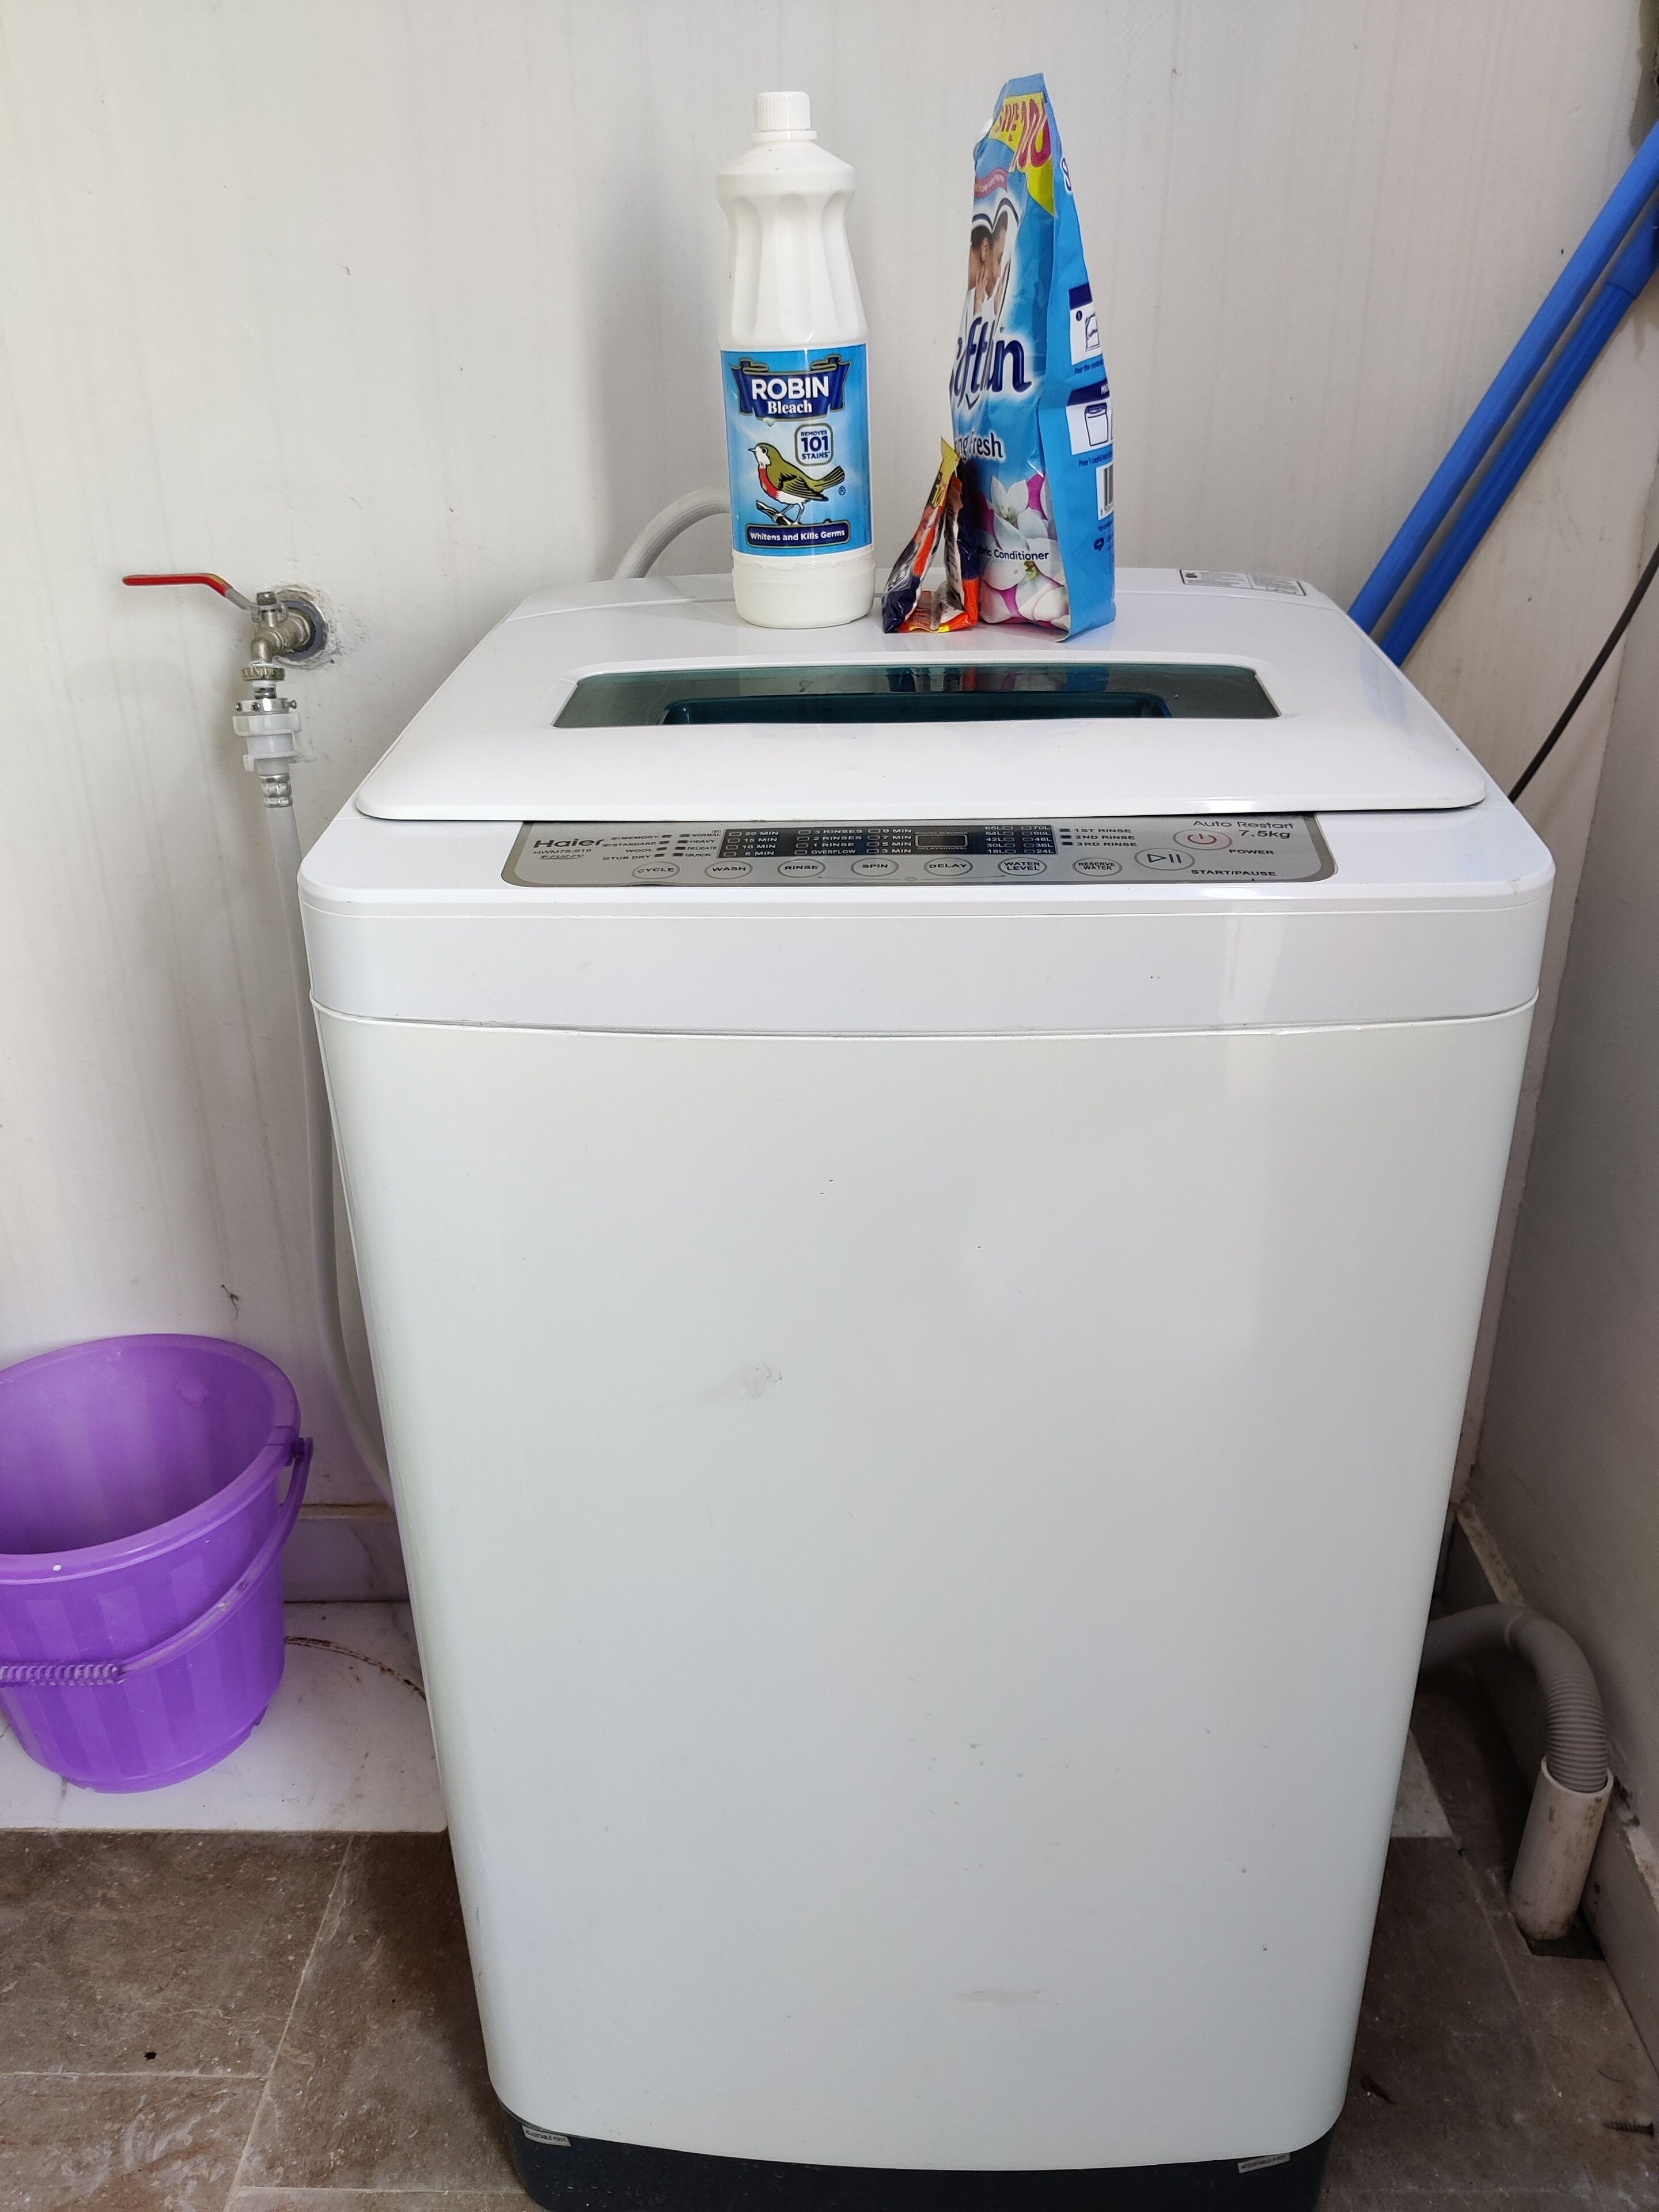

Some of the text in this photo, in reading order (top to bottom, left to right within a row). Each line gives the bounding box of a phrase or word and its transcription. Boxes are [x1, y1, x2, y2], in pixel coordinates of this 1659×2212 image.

[751, 376, 829, 400] ROBIN
[766, 399, 813, 414] Bleach
[801, 435, 828, 453] 101
[749, 532, 781, 541] Whitens
[782, 533, 798, 541] and
[820, 529, 845, 539] Germs
[994, 549, 1049, 560] Conditioner
[1238, 830, 1290, 839] 7.5kg
[533, 838, 605, 848] Haier
